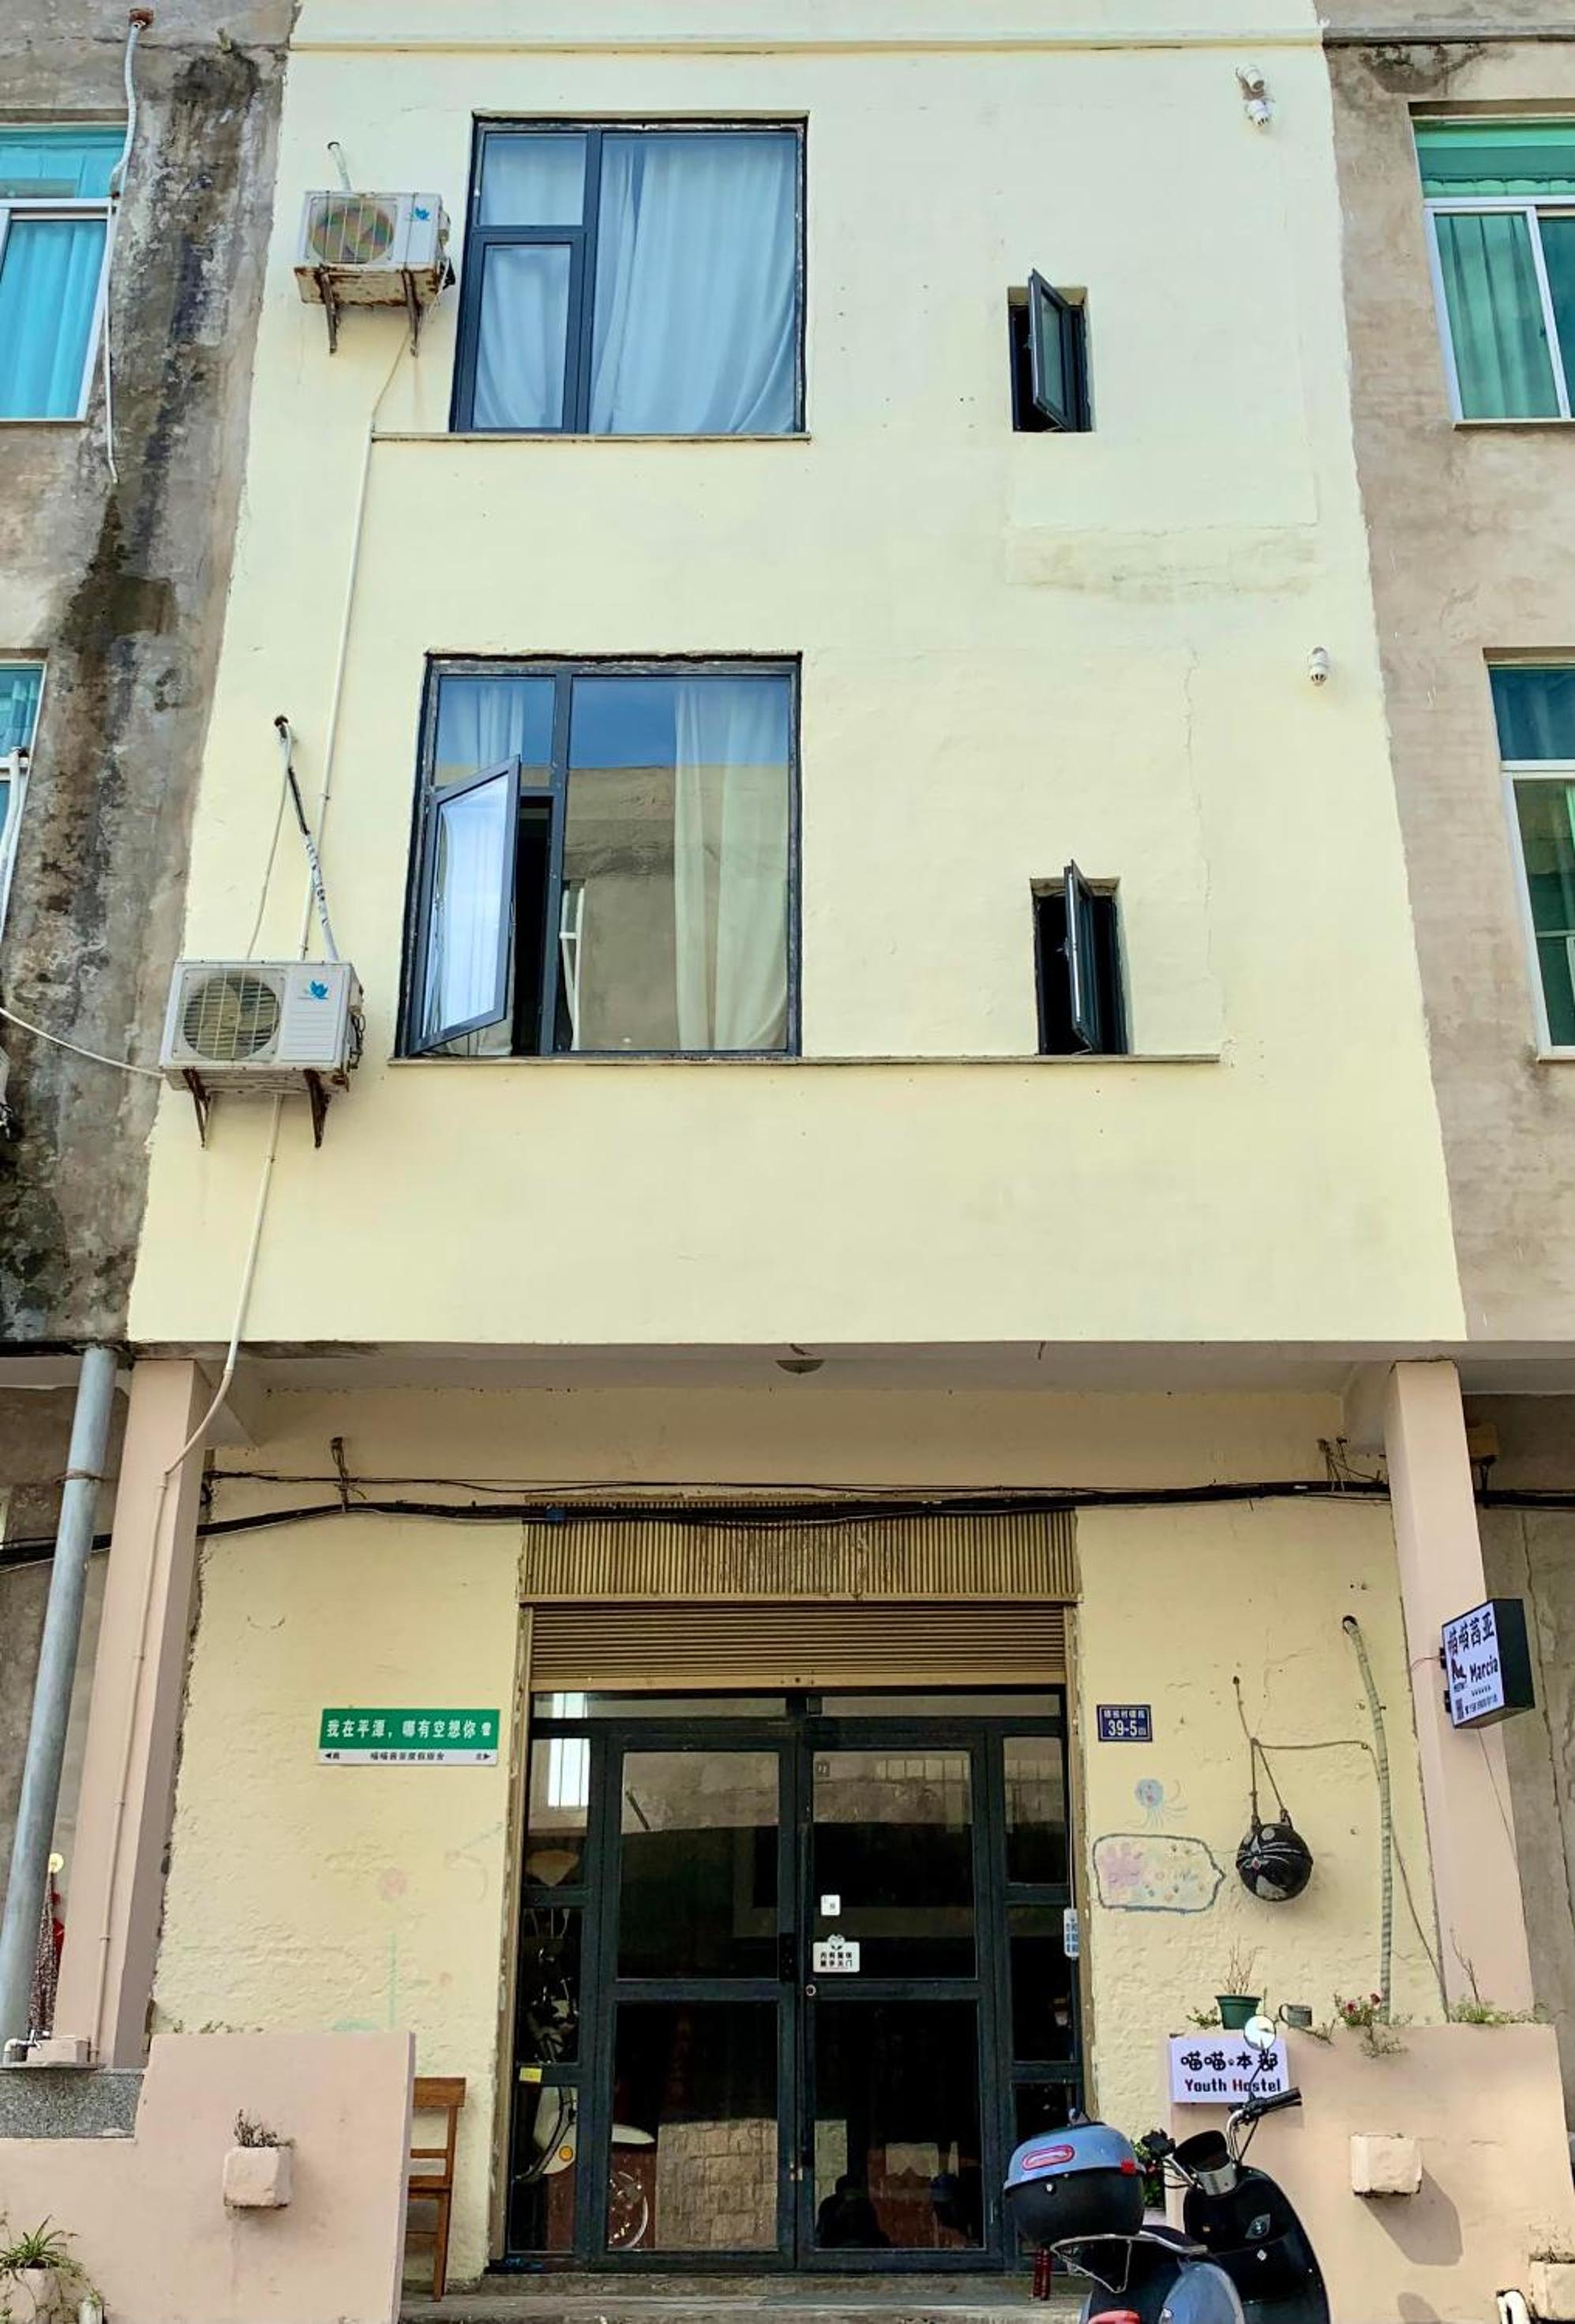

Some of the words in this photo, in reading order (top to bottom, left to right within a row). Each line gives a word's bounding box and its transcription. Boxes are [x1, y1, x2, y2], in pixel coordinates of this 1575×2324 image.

[1470, 1656, 1499, 1683] Marcia
[1184, 2078, 1227, 2092] Youth
[1232, 2078, 1282, 2092] Hostel
